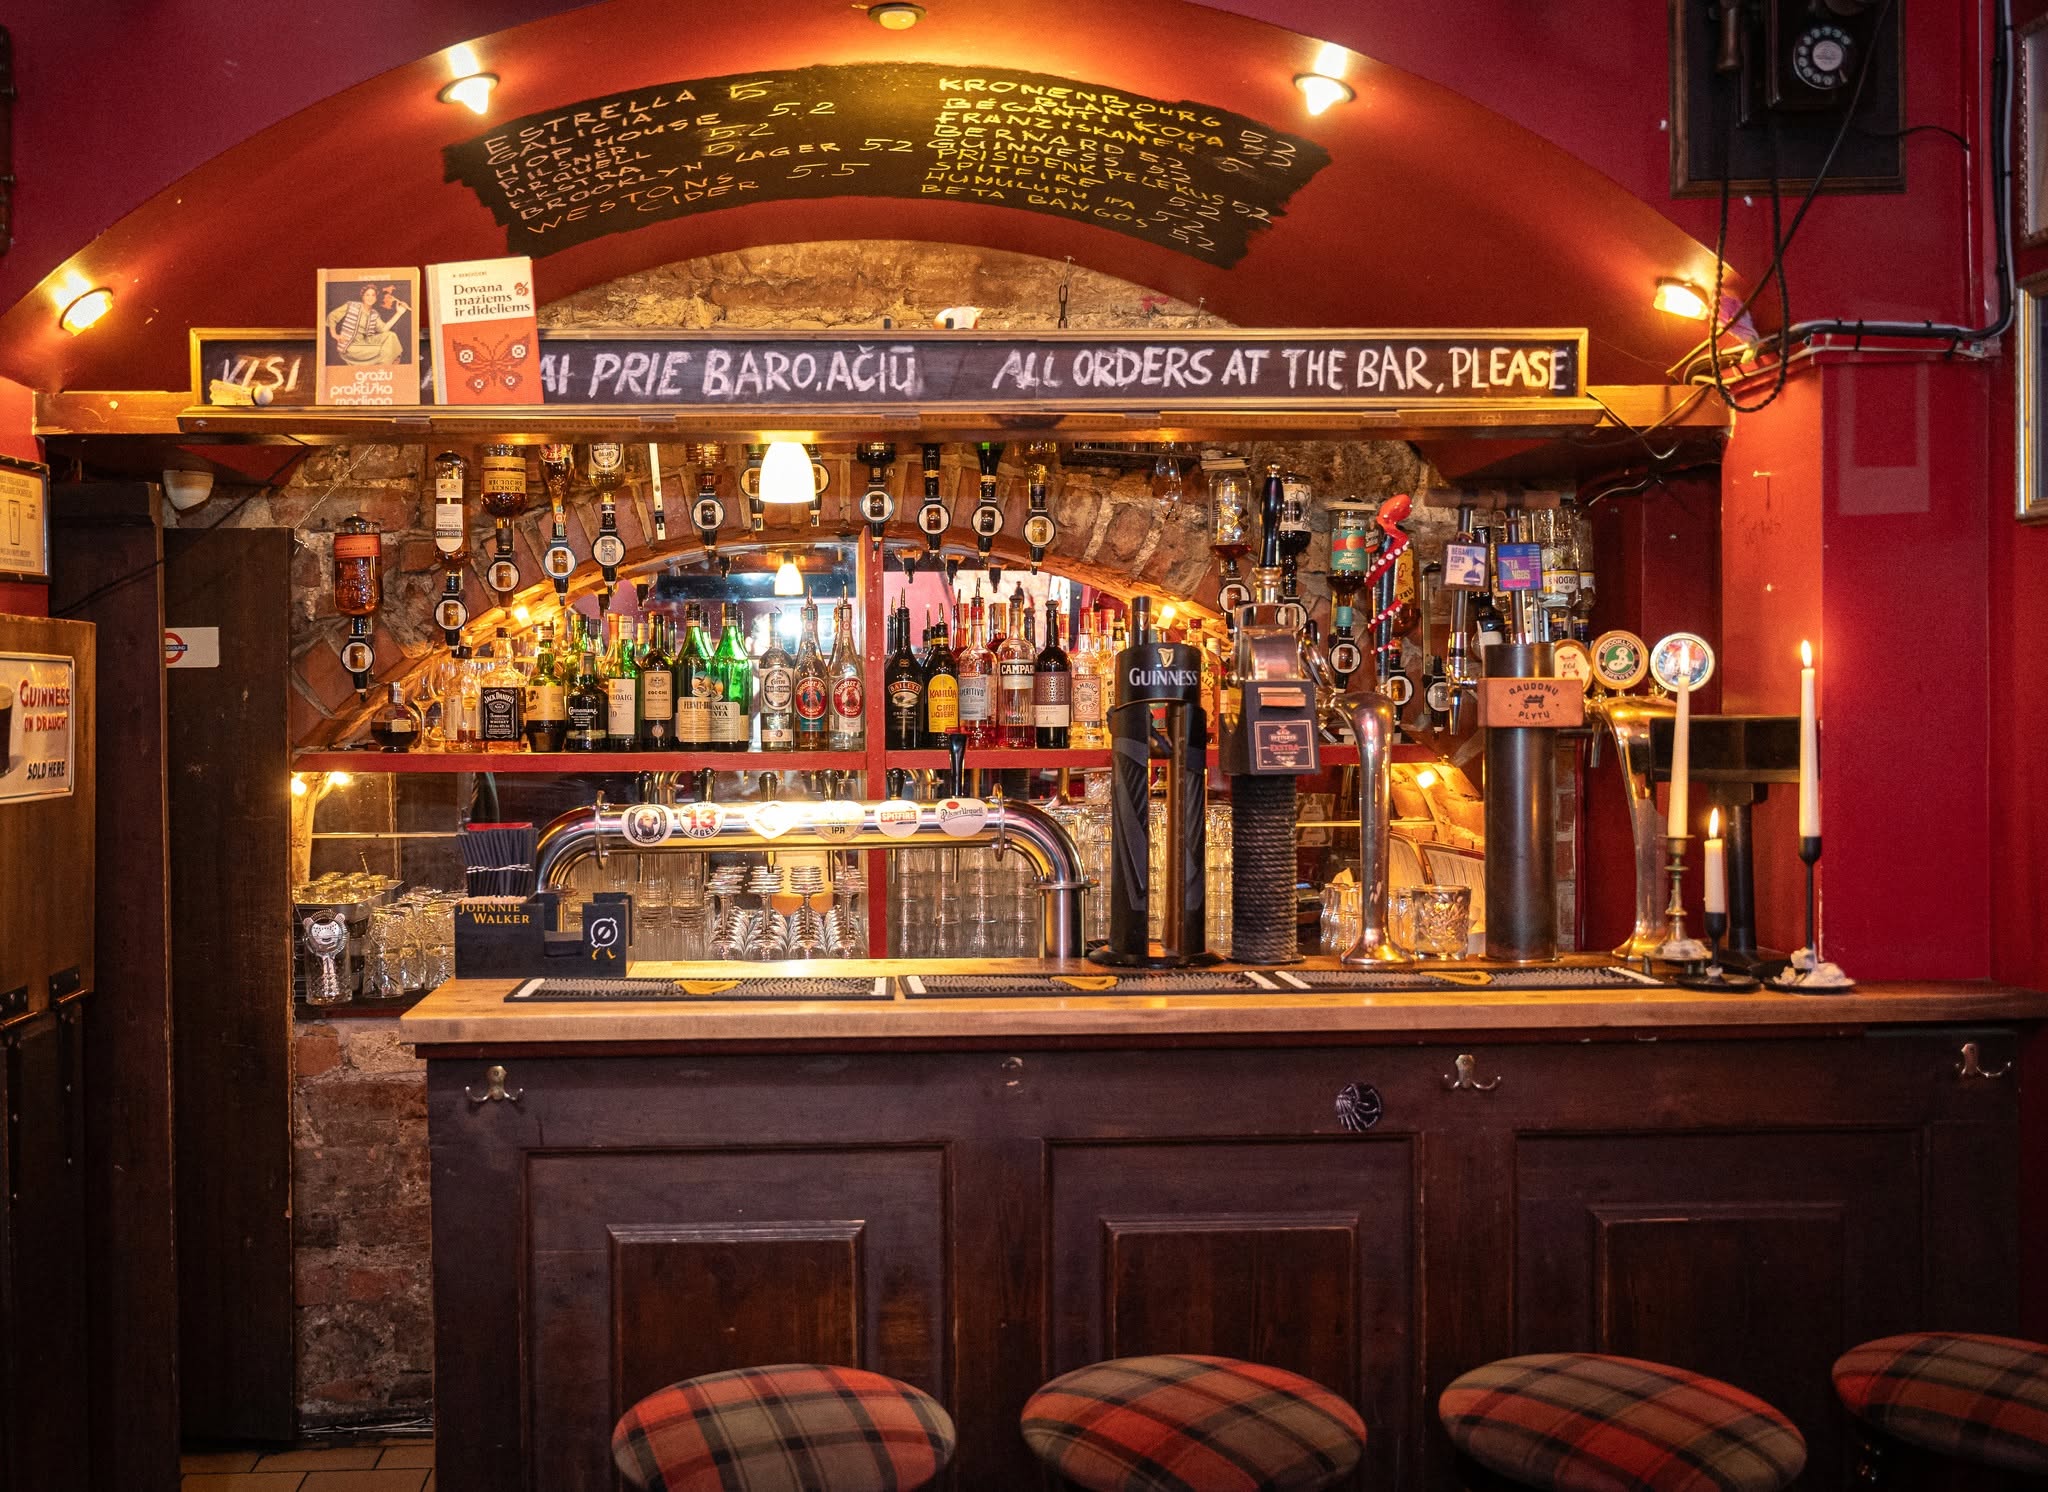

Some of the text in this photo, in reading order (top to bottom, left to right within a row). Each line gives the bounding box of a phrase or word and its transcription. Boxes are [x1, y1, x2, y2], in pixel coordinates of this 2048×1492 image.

[938, 78, 1222, 127] KRONENBOURG
[484, 80, 774, 155] ESTRELLA 5
[487, 101, 836, 166] GALICIA 5.2
[496, 113, 775, 179] HOP HOUSE 5.2
[934, 124, 1125, 155] BERNARD
[935, 111, 1195, 155] FRANZISKANER
[1133, 120, 1224, 147] KOPA
[927, 138, 1119, 167] GUINNESS
[498, 146, 627, 190] PILSNER
[505, 151, 652, 198] URQUELL
[509, 138, 913, 210] EKSTRA LAGER 5.2
[928, 162, 1105, 188] SPITFIRE
[937, 149, 1096, 175] PRISIDENK
[1104, 168, 1225, 205] PELEKUS
[520, 161, 871, 221] BROOKLYN 5.5
[527, 172, 735, 234] WESTONS
[636, 181, 760, 212] CIDER
[925, 172, 1088, 200] HUMULUPU
[1104, 196, 1136, 210] IPA
[920, 184, 1005, 199] BETA
[1028, 194, 1149, 228] BANGOS
[453, 284, 503, 295] Dovana
[454, 293, 513, 306] mažiems
[455, 303, 531, 317] ir dideliems
[222, 355, 302, 392] VISI
[588, 350, 692, 398] PRIE
[992, 350, 1064, 389] ALL
[1072, 346, 1214, 388] ORDERS
[1221, 348, 1270, 388] AT
[1282, 348, 1347, 391] THE
[1357, 345, 1446, 393] BAR,
[1448, 346, 1569, 391] PLEASE
[1512, 570, 1530, 579] NGOS
[1600, 639, 1635, 656] BROOKLYN
[1001, 664, 1035, 674] CAMPAR
[1129, 667, 1199, 687] GUINNESS
[1604, 667, 1637, 681] BREWERY
[20, 679, 70, 708] GUINNESS
[890, 682, 920, 692] BAILEYS
[960, 688, 985, 697] PERITIVO
[24, 713, 67, 732] ON DRAUGHT
[27, 760, 65, 780] SOLD HERE
[688, 810, 716, 828] 13
[881, 811, 916, 821] SPITFIRE
[688, 825, 716, 837] LAGER
[831, 826, 845, 834] IPA
[459, 903, 521, 914] JOHNNIE
[473, 912, 530, 924] WALKER
